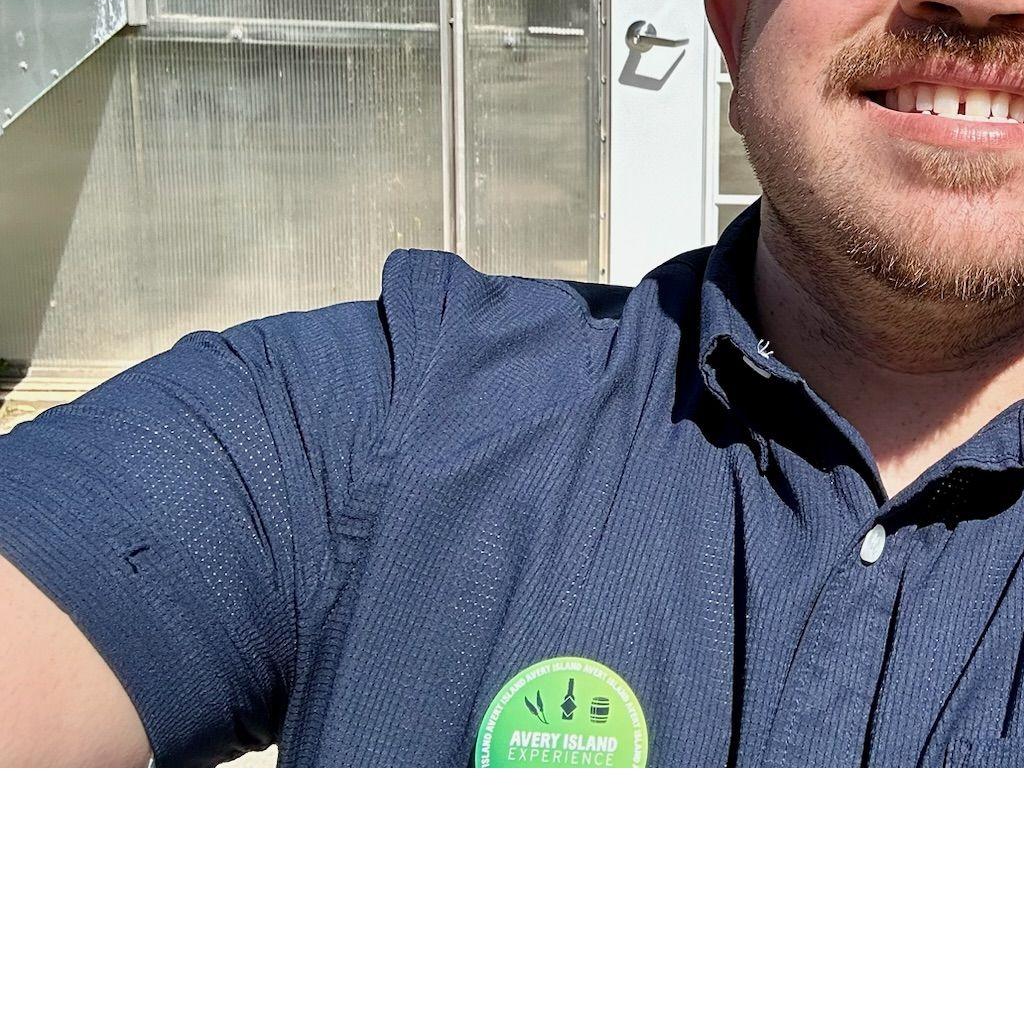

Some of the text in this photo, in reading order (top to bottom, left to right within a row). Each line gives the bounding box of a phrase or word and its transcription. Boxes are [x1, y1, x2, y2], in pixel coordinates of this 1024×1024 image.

[509, 730, 618, 752] AVERY ISLAND
[507, 747, 614, 766] EXPERIENCE
